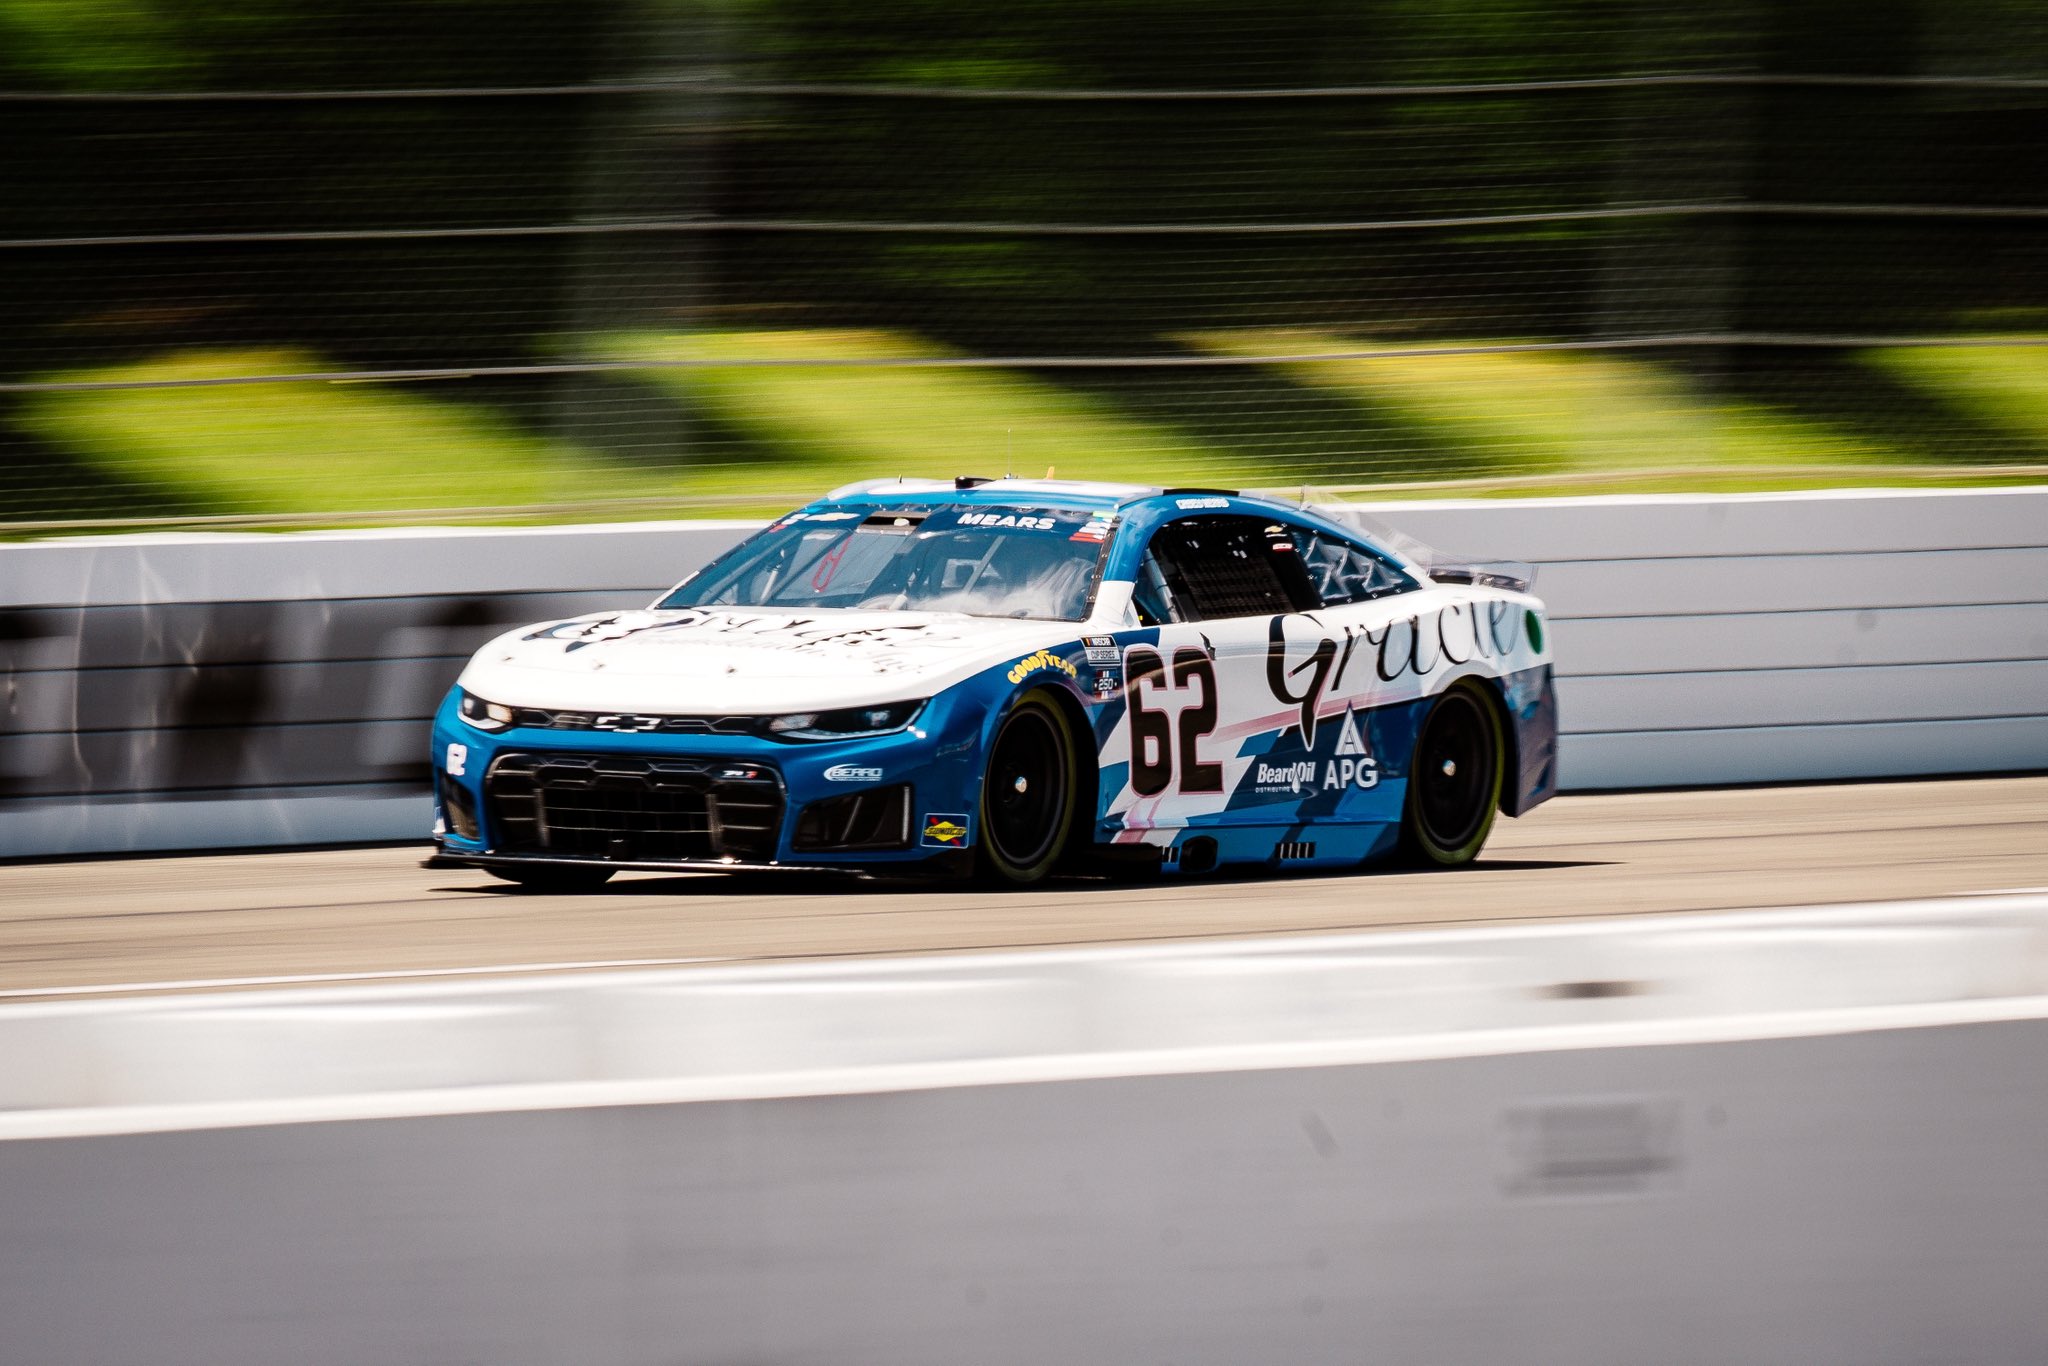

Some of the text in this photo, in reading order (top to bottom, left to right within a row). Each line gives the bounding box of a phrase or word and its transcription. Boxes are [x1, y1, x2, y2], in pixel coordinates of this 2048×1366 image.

[957, 513, 1056, 530] MEARS
[1007, 650, 1077, 685] GOODYEAR
[1100, 651, 1115, 659] SERIES
[1098, 678, 1113, 691] 250
[1266, 599, 1519, 752] Gracie
[1123, 644, 1226, 799] 62
[1257, 761, 1316, 783] Beard Oil
[1323, 758, 1379, 791] APG
